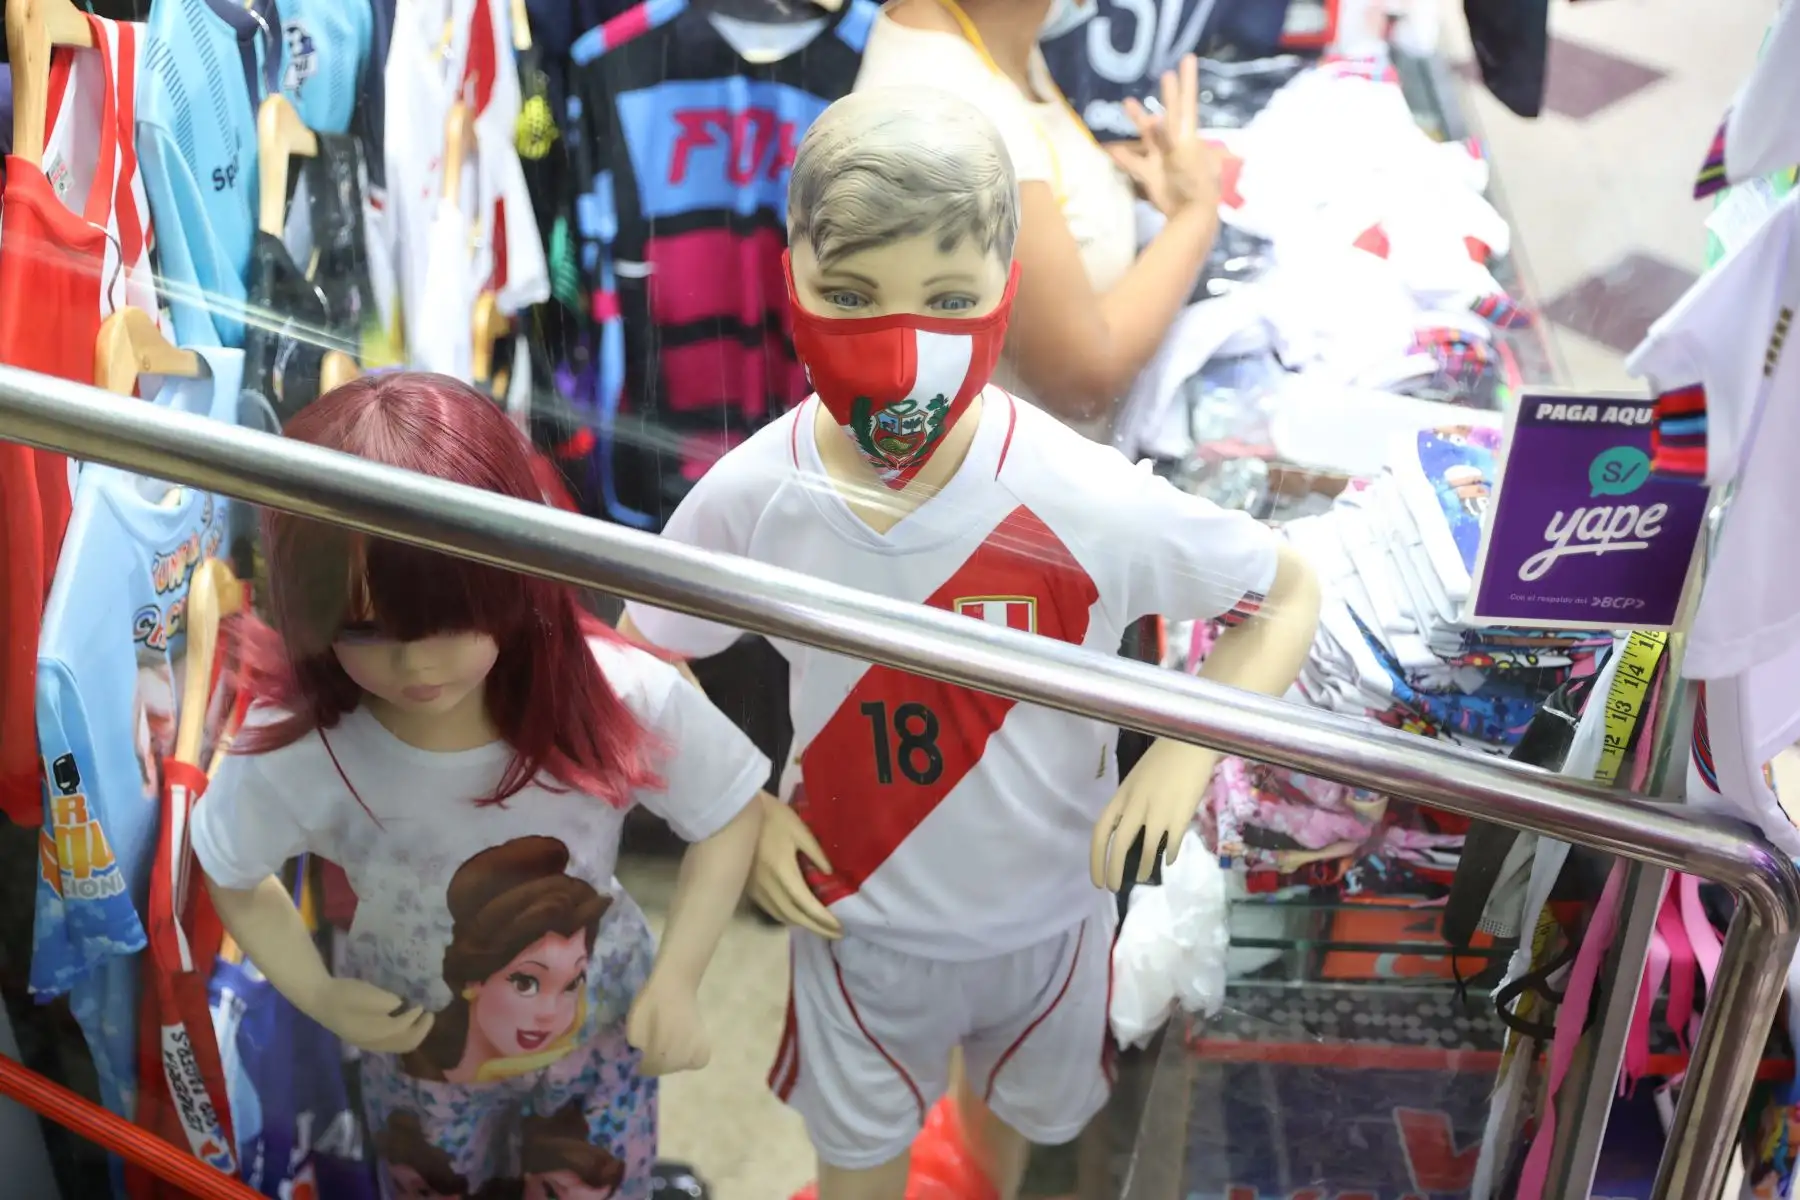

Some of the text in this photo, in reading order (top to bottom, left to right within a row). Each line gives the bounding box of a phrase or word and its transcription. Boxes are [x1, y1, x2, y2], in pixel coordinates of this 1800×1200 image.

[1536, 403, 1655, 426] PAGA AQU
[1518, 503, 1669, 582] yape
[860, 701, 944, 786] 18
